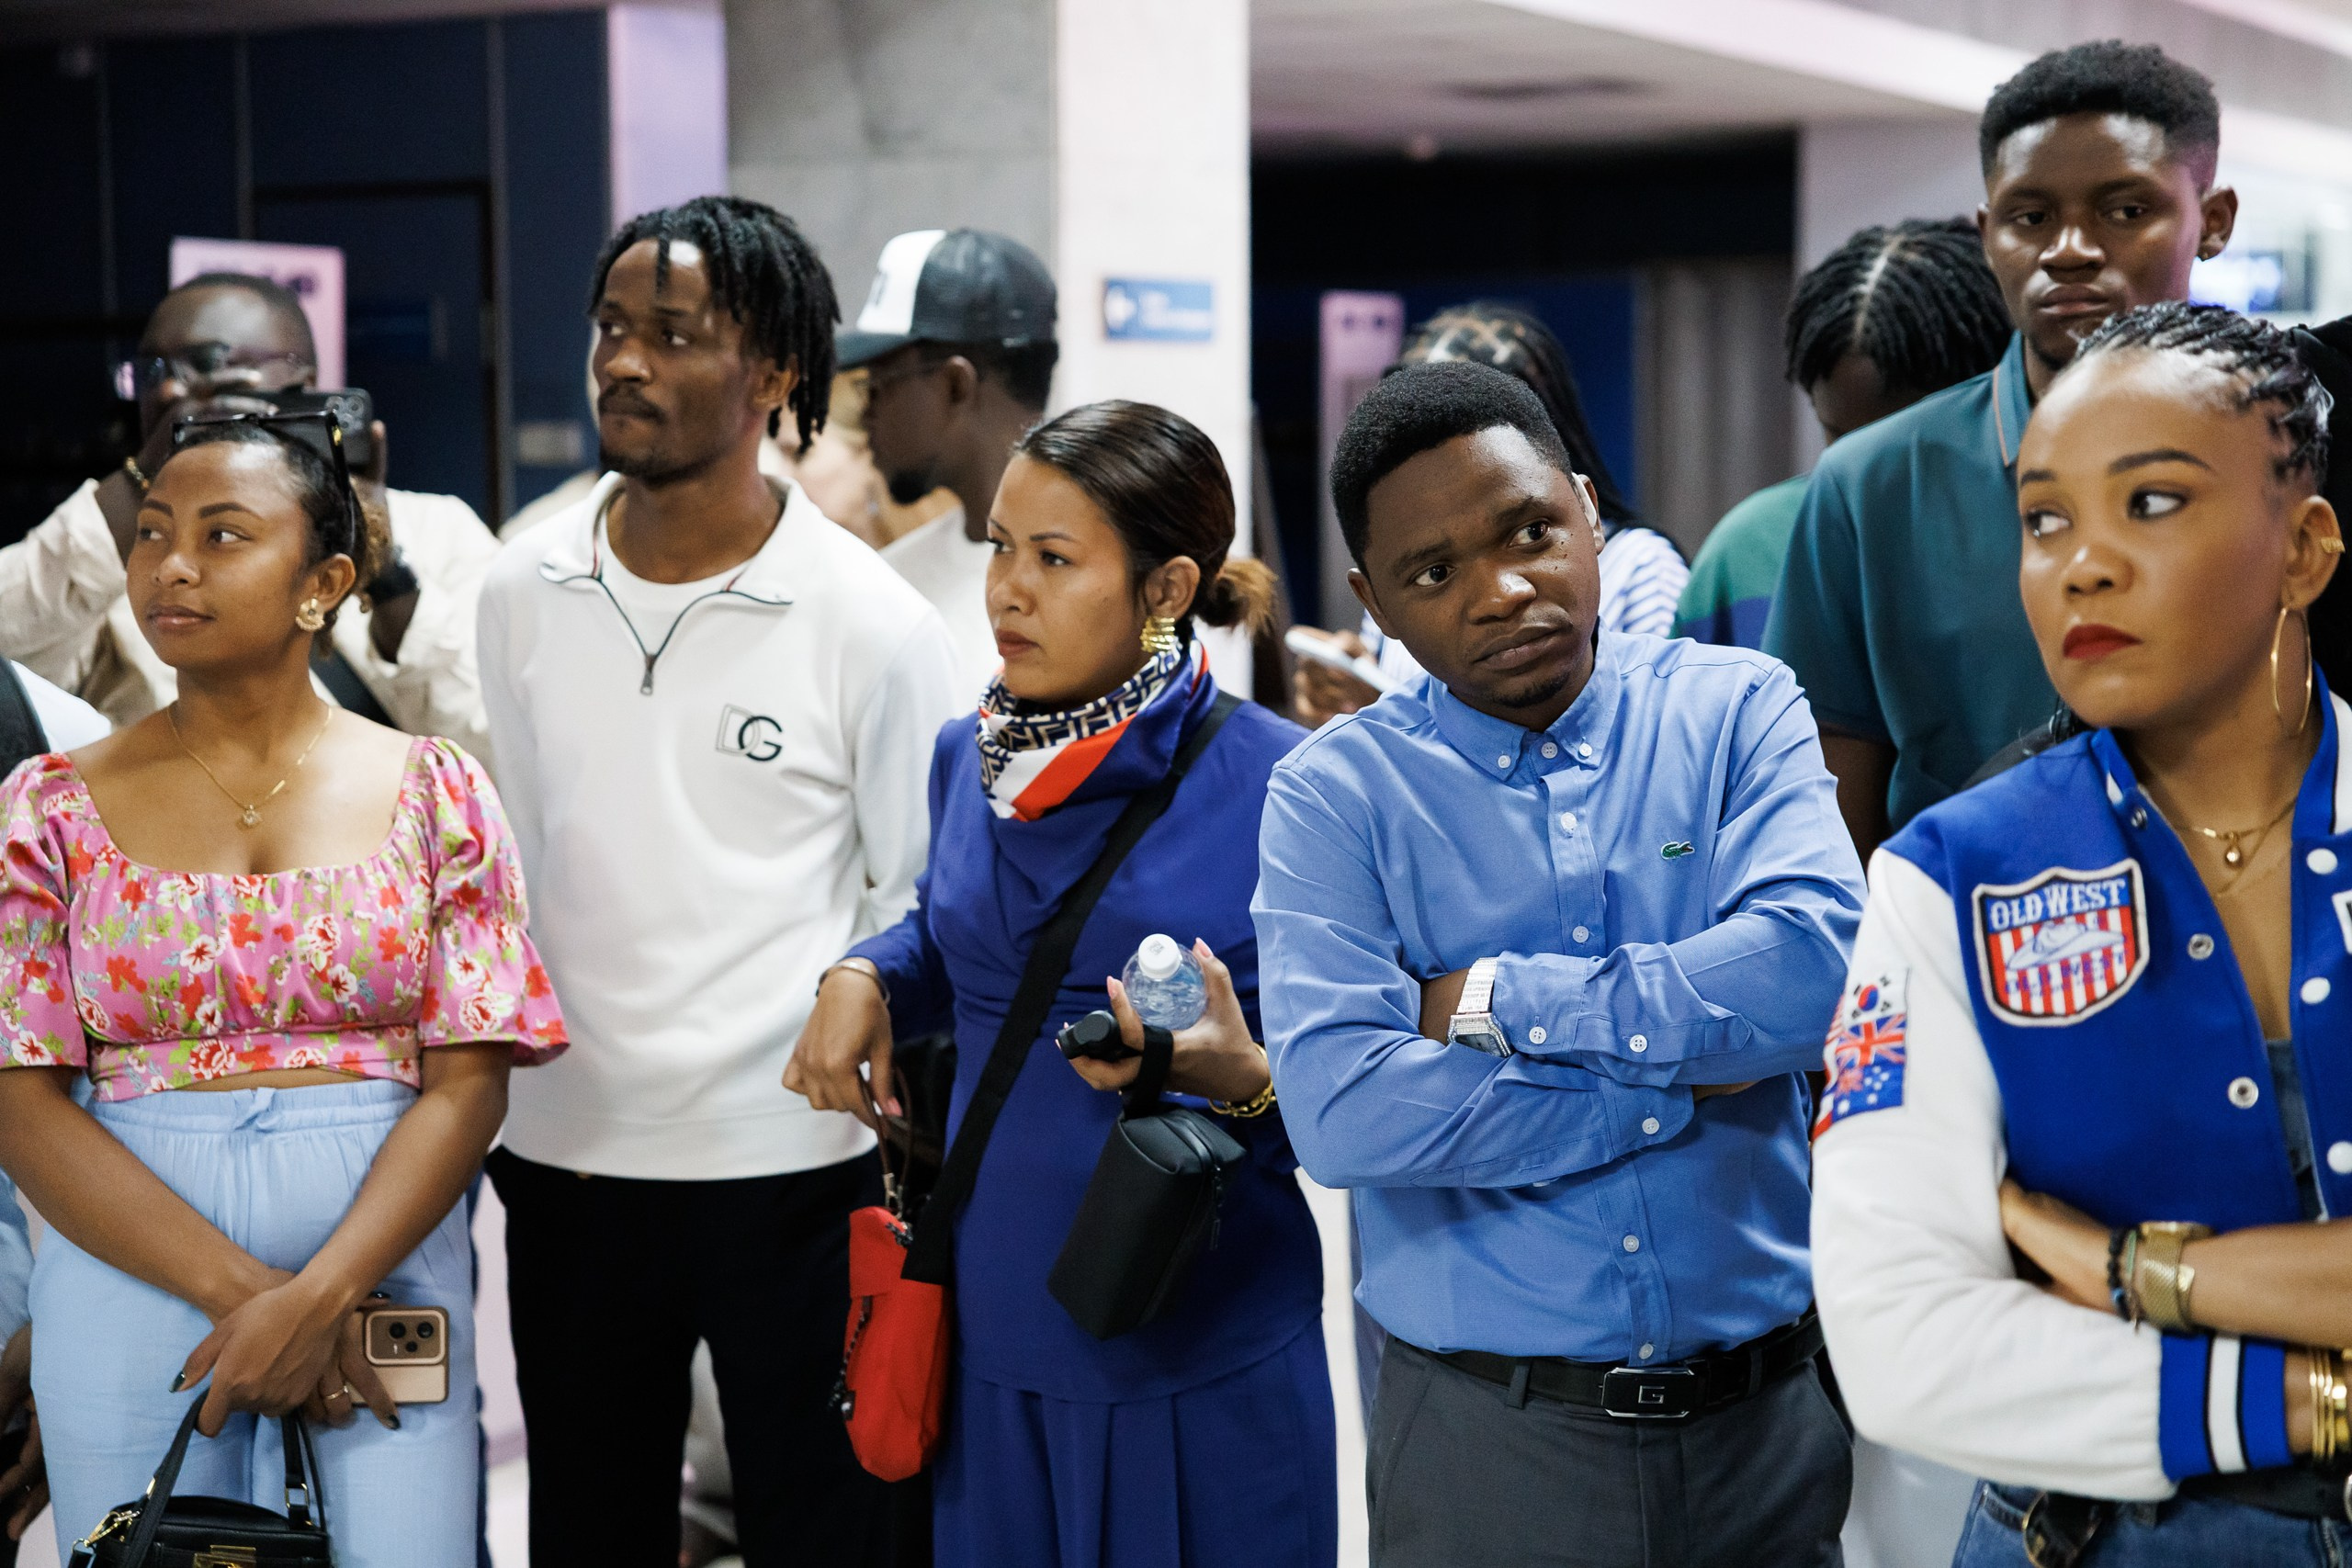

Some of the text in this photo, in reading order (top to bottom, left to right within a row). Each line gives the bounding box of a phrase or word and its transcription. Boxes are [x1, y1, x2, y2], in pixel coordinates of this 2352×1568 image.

[1991, 878, 2126, 930] OLD WEST
[1638, 1385, 1665, 1404] G
